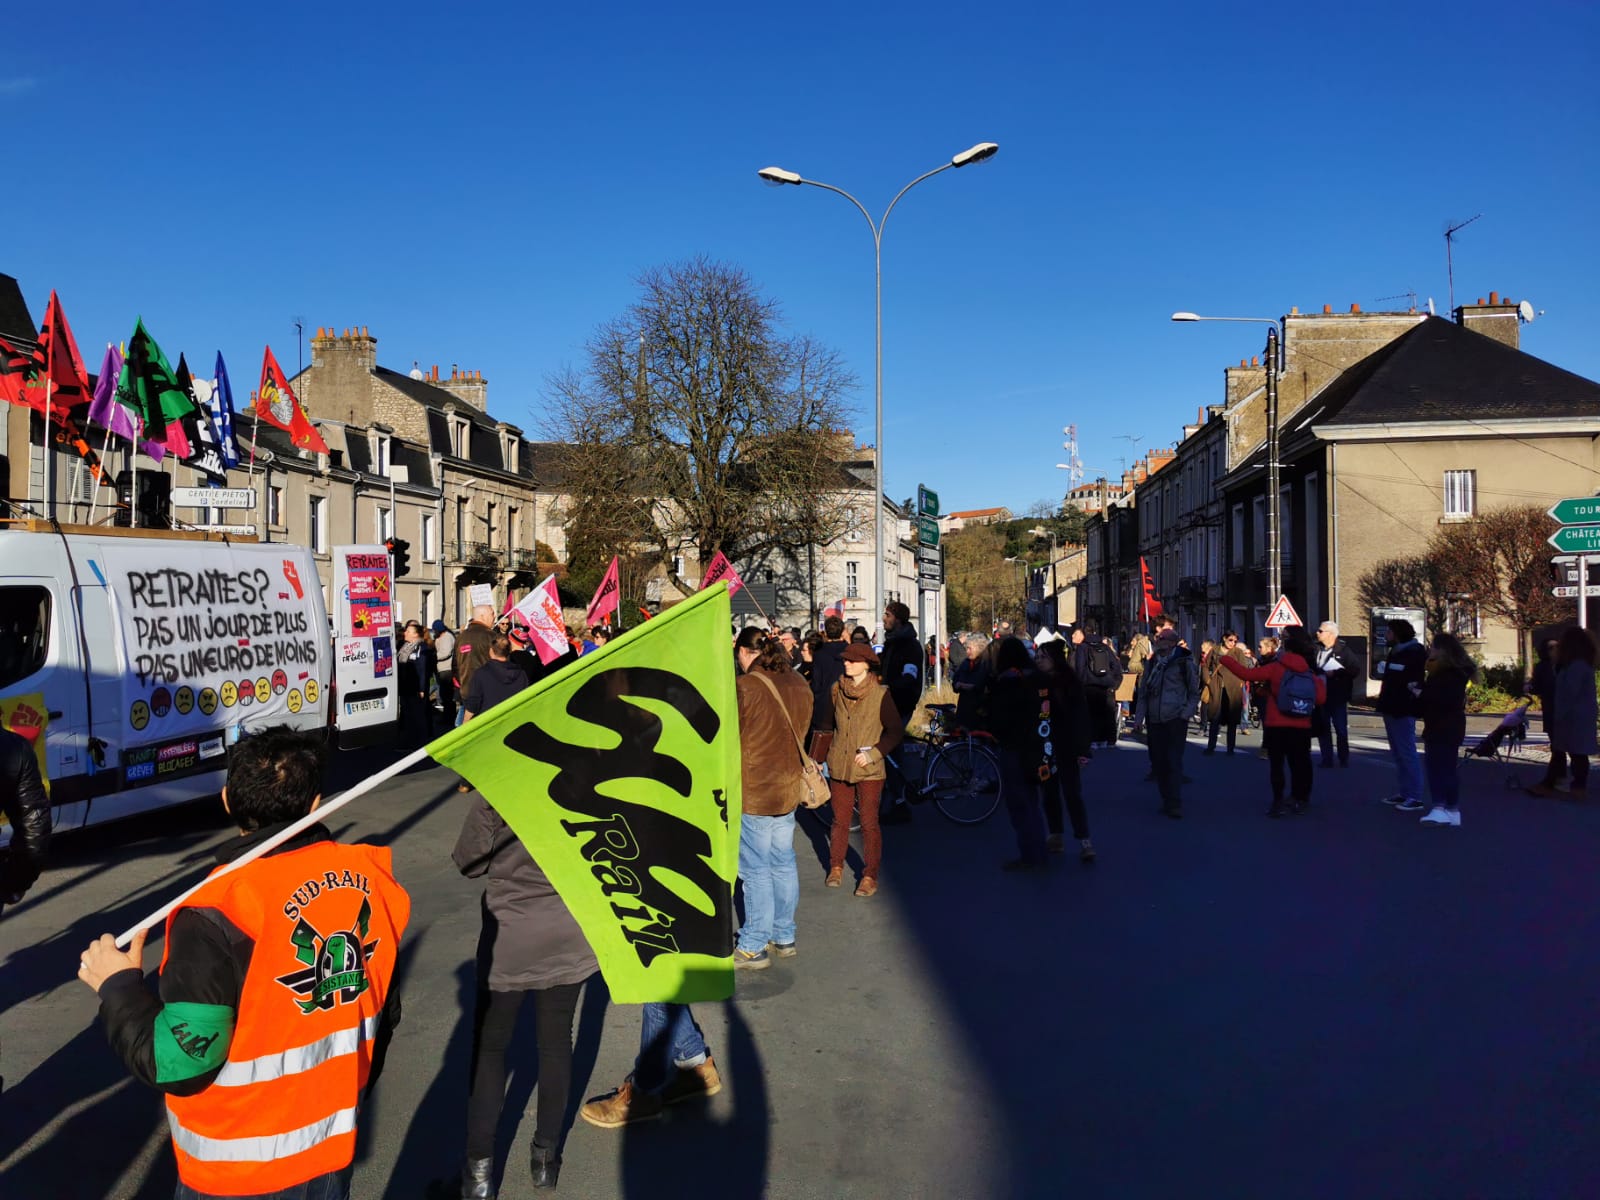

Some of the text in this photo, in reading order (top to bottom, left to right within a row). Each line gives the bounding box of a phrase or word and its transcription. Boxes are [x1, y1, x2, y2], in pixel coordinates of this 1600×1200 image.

[188, 490, 219, 498] CENTE
[346, 554, 388, 568] RETRAITES
[127, 567, 270, 609] RETRAITES?
[133, 615, 174, 650] PAS
[176, 614, 202, 642] UN
[250, 612, 273, 637] DE
[273, 611, 307, 635] PLUS
[135, 653, 180, 688] PAS
[180, 648, 205, 678] UN
[253, 644, 275, 667] DE
[283, 869, 370, 921] SUD-RAIL
